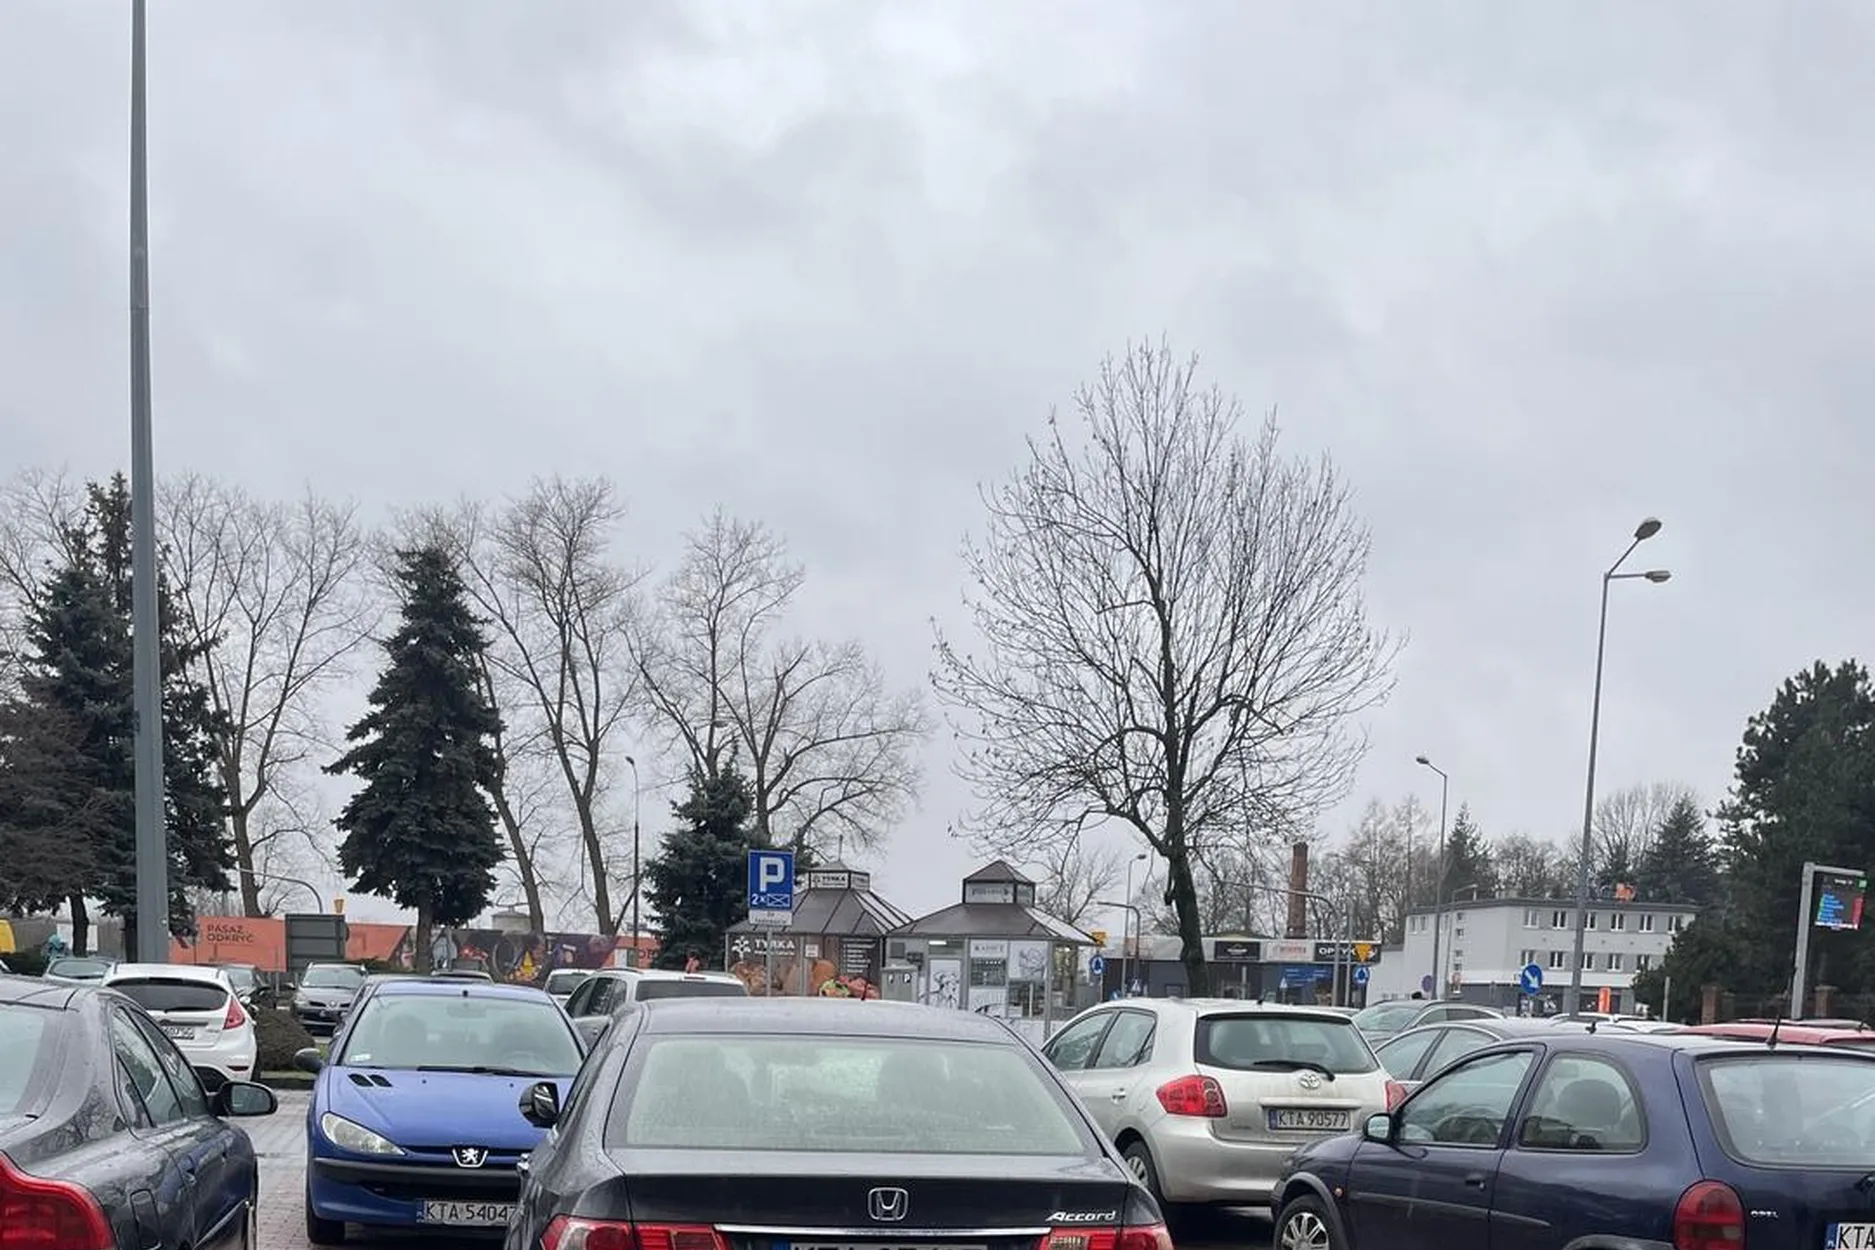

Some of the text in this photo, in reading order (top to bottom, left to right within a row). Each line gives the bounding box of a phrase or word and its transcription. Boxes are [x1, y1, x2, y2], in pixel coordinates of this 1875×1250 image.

[760, 857, 785, 892] P
[1279, 1110, 1304, 1126] KTA
[426, 1203, 459, 1220] KTA
[1045, 1210, 1116, 1222] Accord
